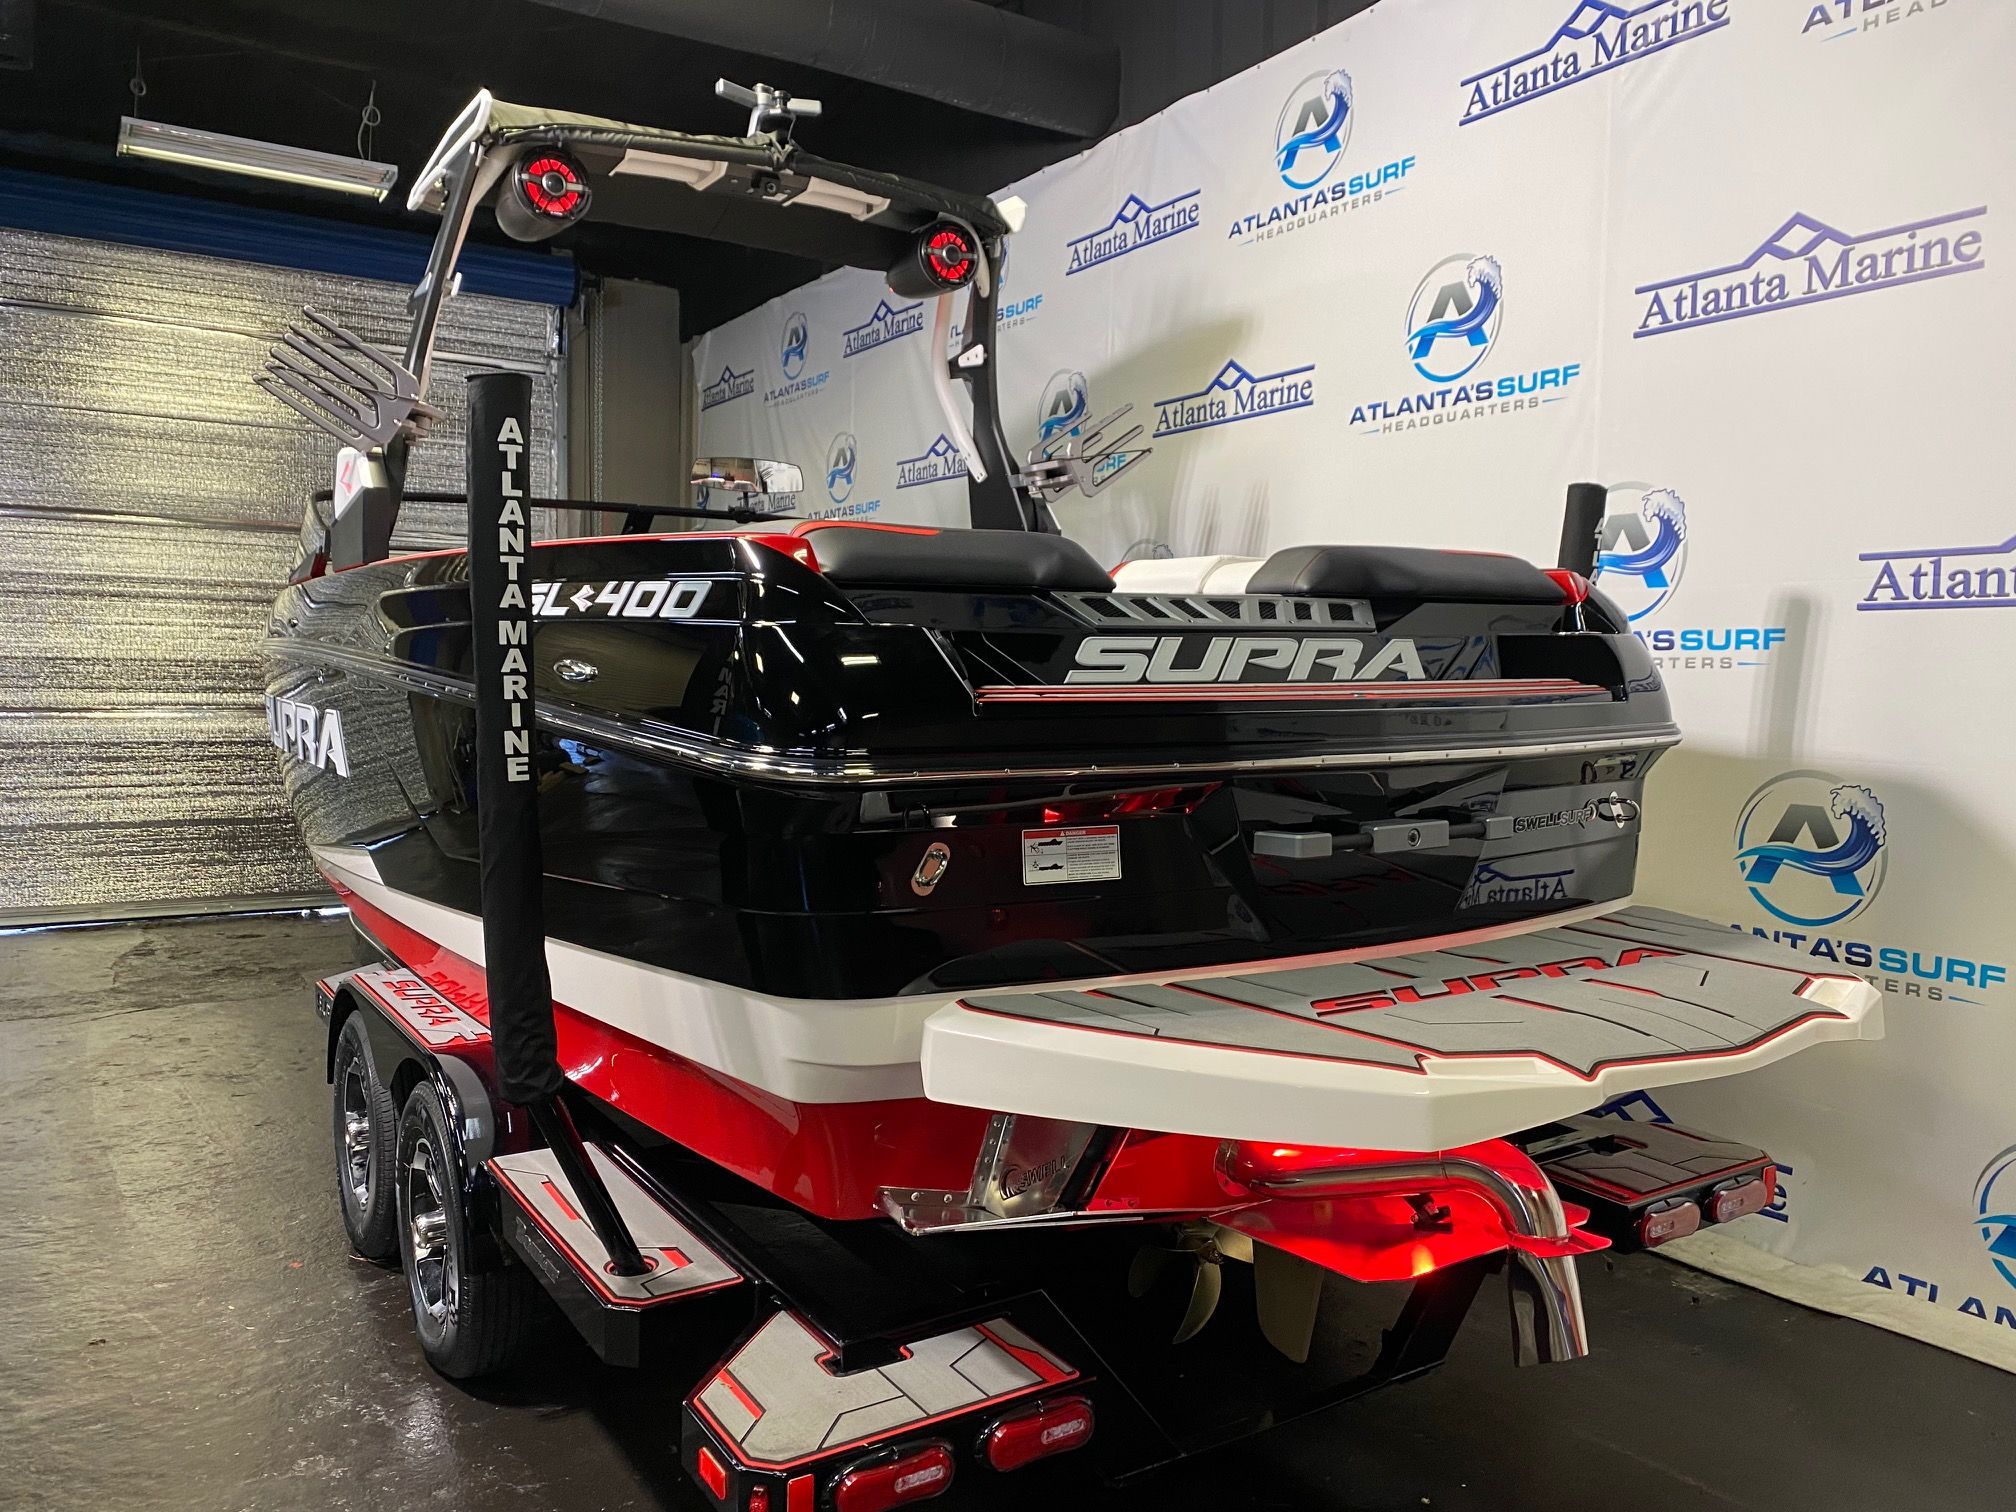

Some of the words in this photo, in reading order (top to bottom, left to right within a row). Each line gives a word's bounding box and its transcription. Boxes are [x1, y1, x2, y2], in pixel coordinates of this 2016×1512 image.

[1463, 51, 1581, 117] Atlanta
[1591, 0, 1729, 67] Marine
[1068, 231, 1128, 270] Atlanta
[1132, 202, 1200, 245] Marine
[1256, 190, 1383, 243] HEADQUARTERS
[1638, 271, 1790, 330] Atlanta
[1801, 229, 1983, 296] Marine
[844, 326, 881, 354] Atlanta
[882, 311, 924, 340] Marine
[1155, 399, 1227, 433] Atlanta
[1232, 377, 1314, 416] Marine
[1382, 396, 1540, 434] HEADQUARTERS
[898, 462, 939, 484] Atlanta
[497, 417, 526, 609] ATLANTA
[594, 580, 713, 618] 400
[1863, 556, 2016, 602] Atlan
[1063, 635, 1426, 684] SUPRA
[498, 620, 530, 782] MARINE
[265, 692, 351, 779] UPRA
[382, 980, 461, 1027] SUPRA
[1310, 947, 1687, 1018] SUPRA
